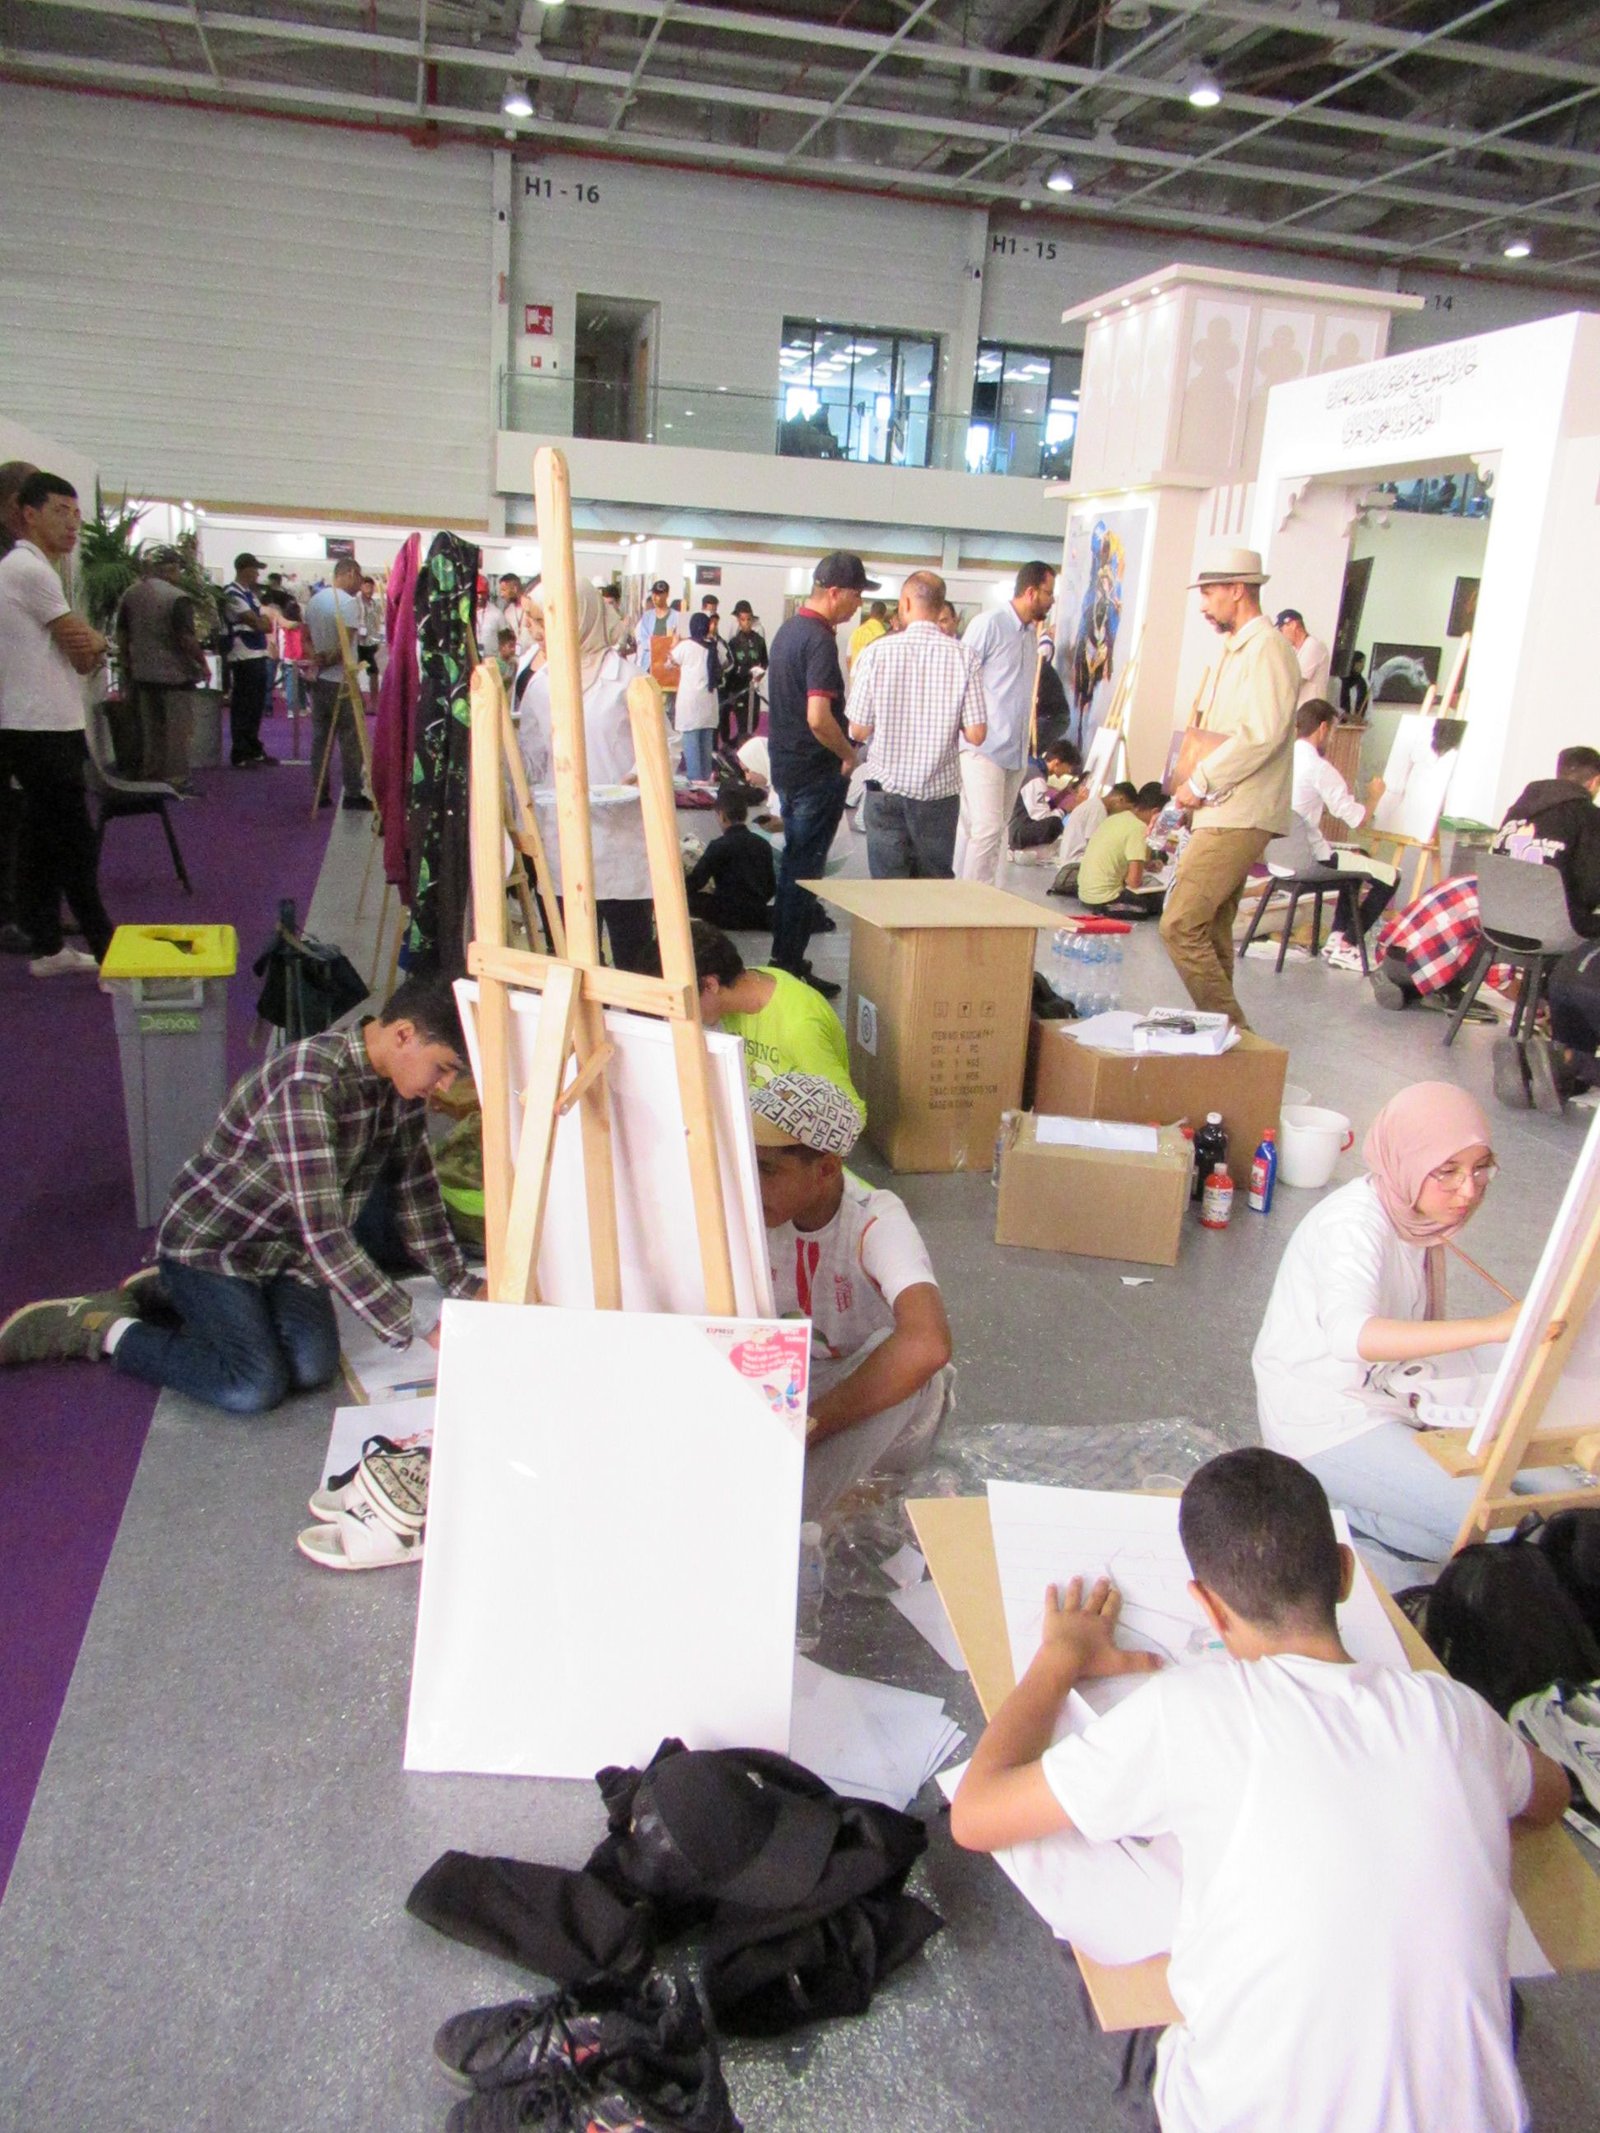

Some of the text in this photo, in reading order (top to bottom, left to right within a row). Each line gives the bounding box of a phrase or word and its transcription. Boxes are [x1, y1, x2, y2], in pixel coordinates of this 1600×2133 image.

[525, 176, 552, 198] H1
[575, 183, 600, 204] 16
[992, 235, 1016, 255] H1
[1036, 242, 1057, 260] 15
[1435, 294, 1453, 313] 14
